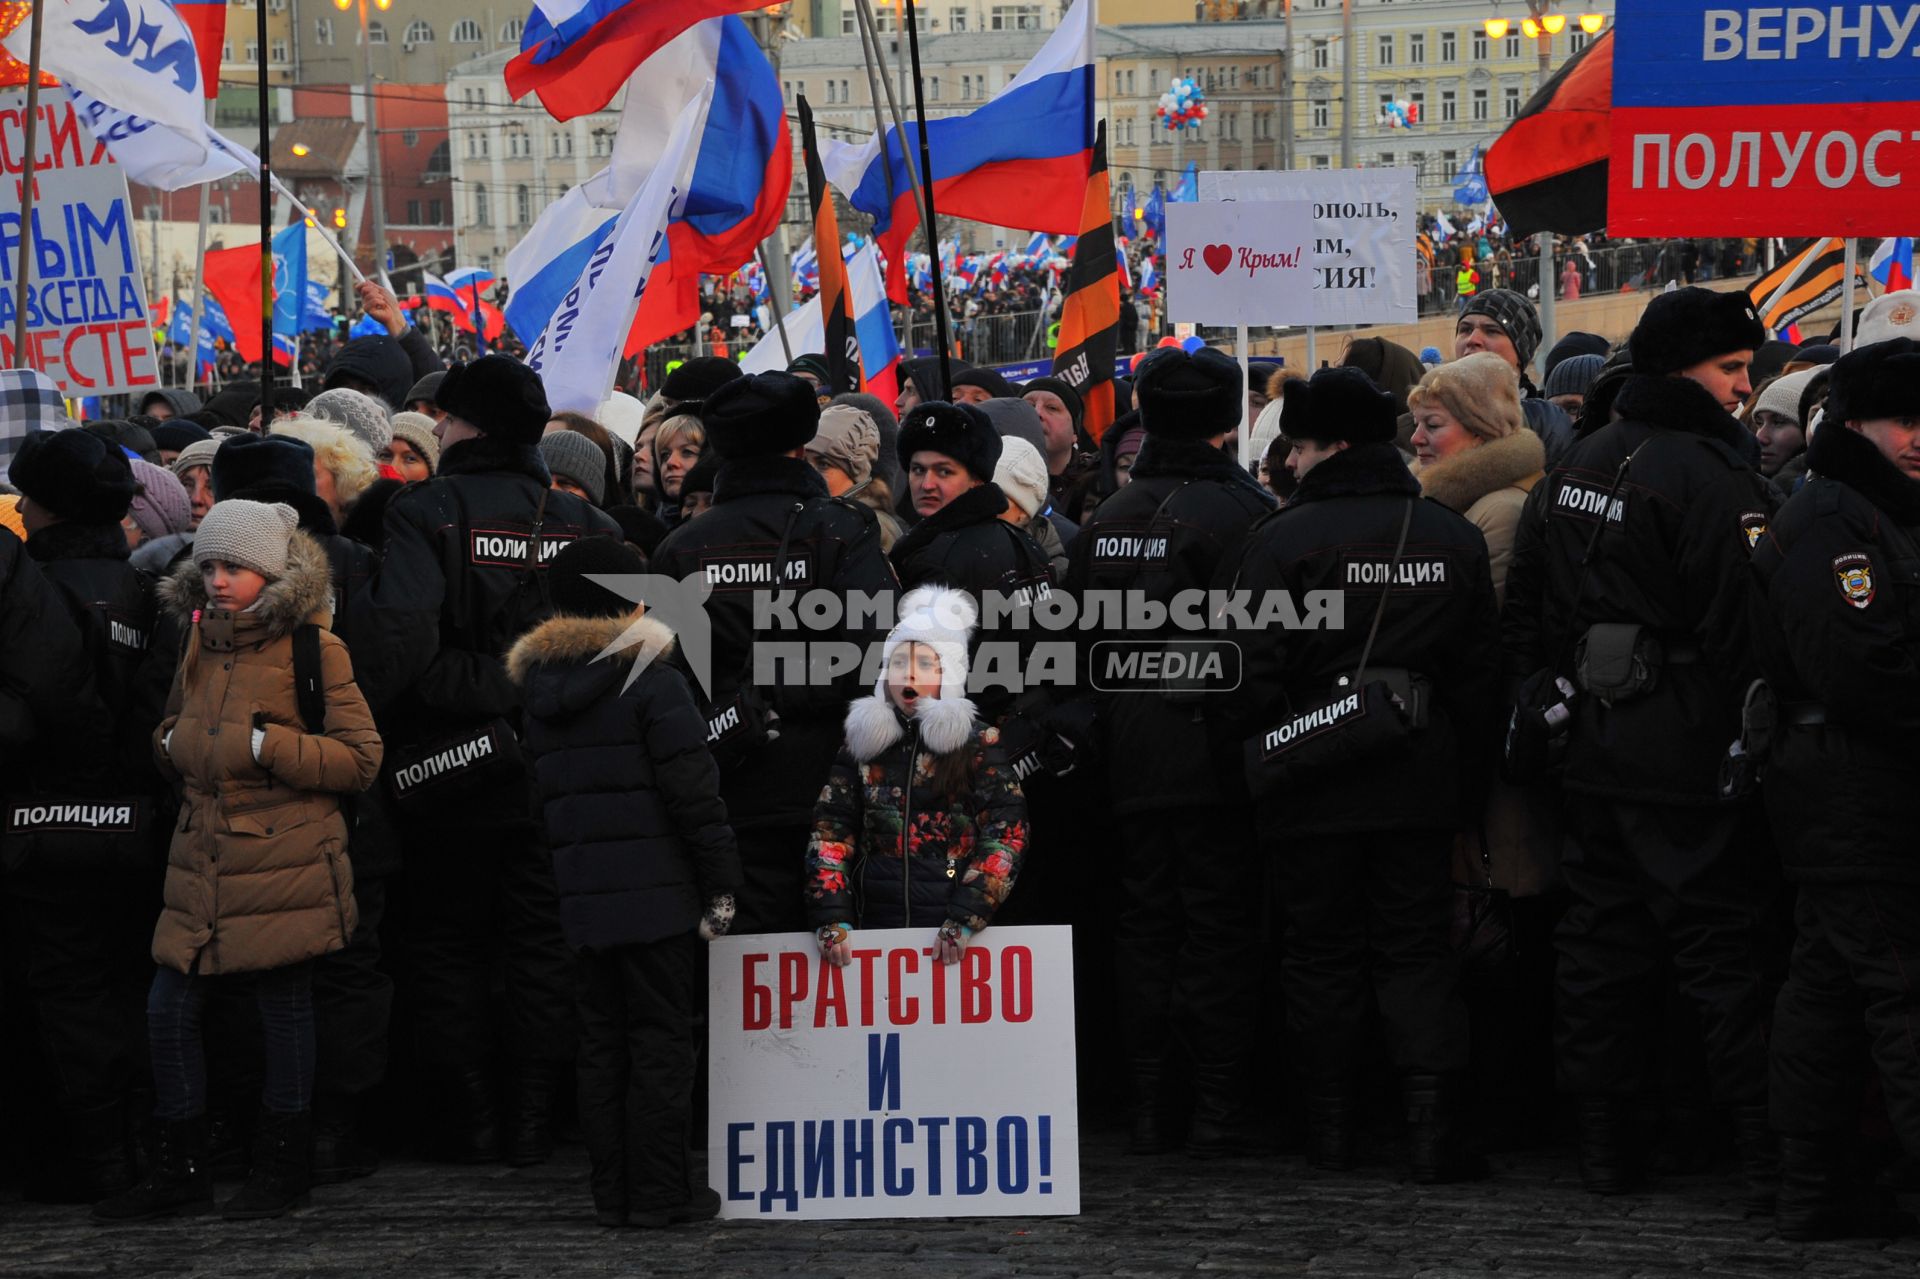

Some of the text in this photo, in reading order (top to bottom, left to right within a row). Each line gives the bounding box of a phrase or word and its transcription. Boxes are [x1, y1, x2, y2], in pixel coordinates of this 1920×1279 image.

[1703, 4, 1920, 61] ВЕРНУ
[0, 100, 117, 176] ССИ
[1179, 247, 1301, 277] Я Крым!
[0, 320, 157, 391] МЕСТЕ
[1265, 693, 1359, 751] ПОЛИЦИЯ
[395, 735, 493, 790] ПОЛИЦИЯ
[14, 805, 130, 827] ПОЛИЦИЯ
[743, 946, 1033, 1030] БРАТСТВО
[868, 1033, 901, 1111] И
[728, 1115, 1052, 1212] ЕДИНСТВО!
